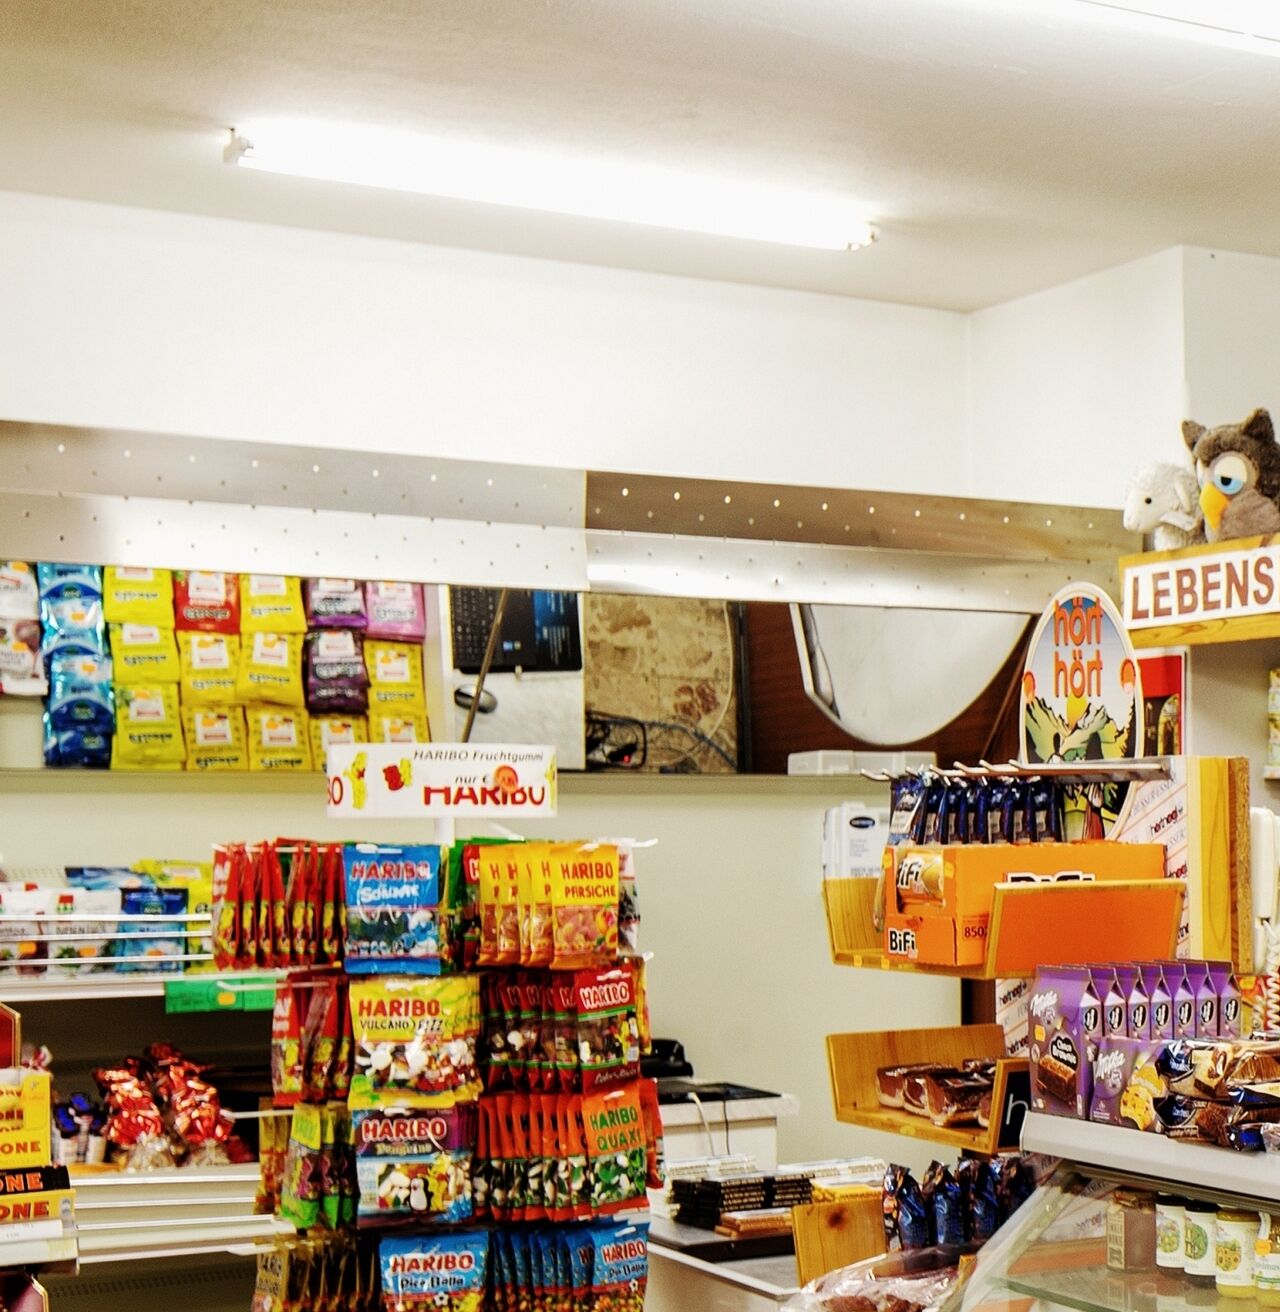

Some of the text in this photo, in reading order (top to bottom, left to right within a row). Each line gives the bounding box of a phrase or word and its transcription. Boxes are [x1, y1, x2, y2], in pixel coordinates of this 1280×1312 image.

[1054, 597, 1104, 646] hört
[1054, 649, 1103, 698] hört
[413, 750, 544, 764] HARIBO Fruchtgummi
[455, 773, 489, 785] nur €
[561, 862, 613, 880] HARIBO
[889, 930, 915, 952] BiFi
[579, 982, 630, 1010] HARIBO
[359, 1000, 440, 1017] HARIBO
[362, 1117, 447, 1141] HARIBO
[590, 1105, 638, 1131] HARIBO
[597, 1130, 641, 1152] QUAXI
[391, 1252, 475, 1274] HARIBO
[603, 1240, 648, 1265] HARIBO
